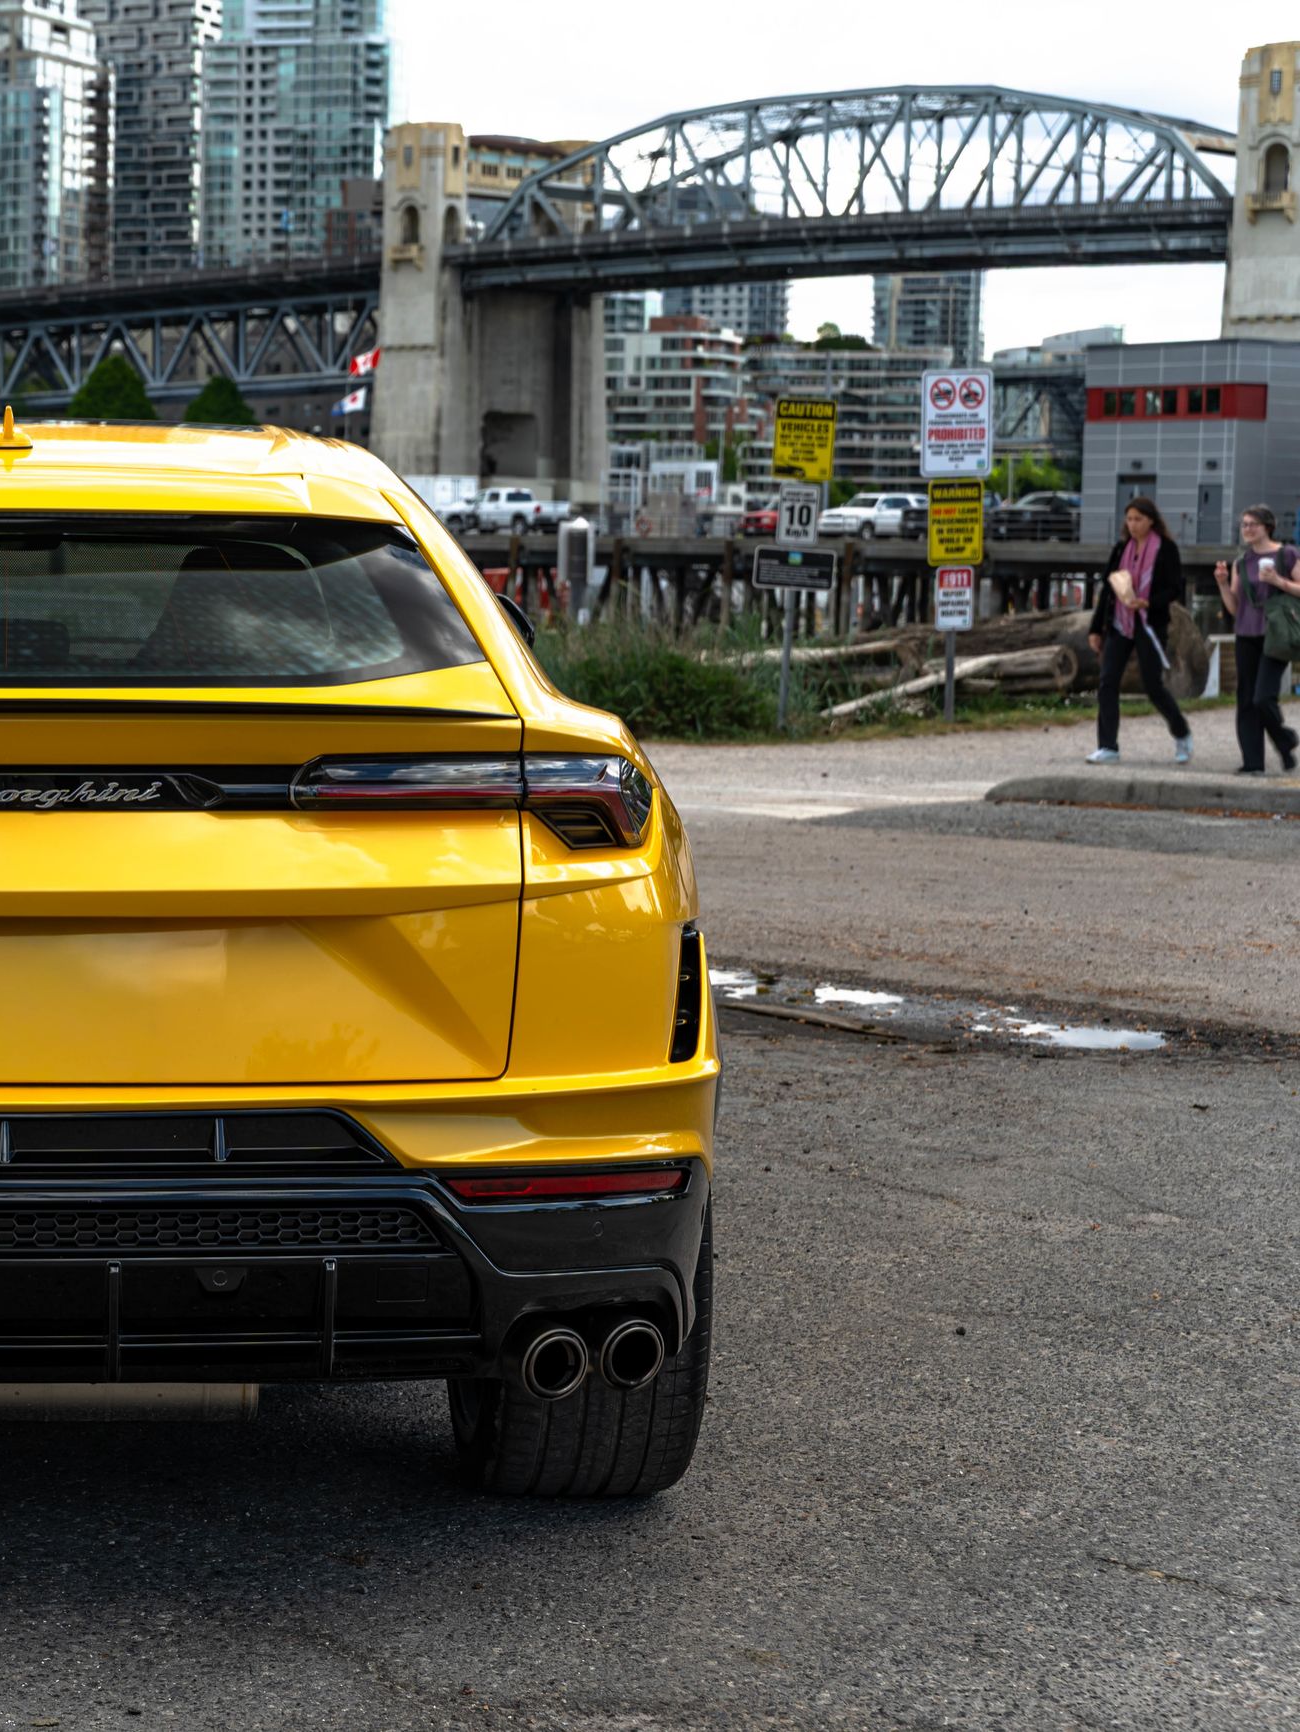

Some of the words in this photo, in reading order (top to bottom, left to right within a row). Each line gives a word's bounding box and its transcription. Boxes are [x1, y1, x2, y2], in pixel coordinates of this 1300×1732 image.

[779, 402, 833, 418] CAUTION
[780, 422, 830, 433] VEHICLES
[927, 427, 986, 441] PROHIBITED
[933, 487, 980, 499] WARNING
[785, 505, 811, 527] 10
